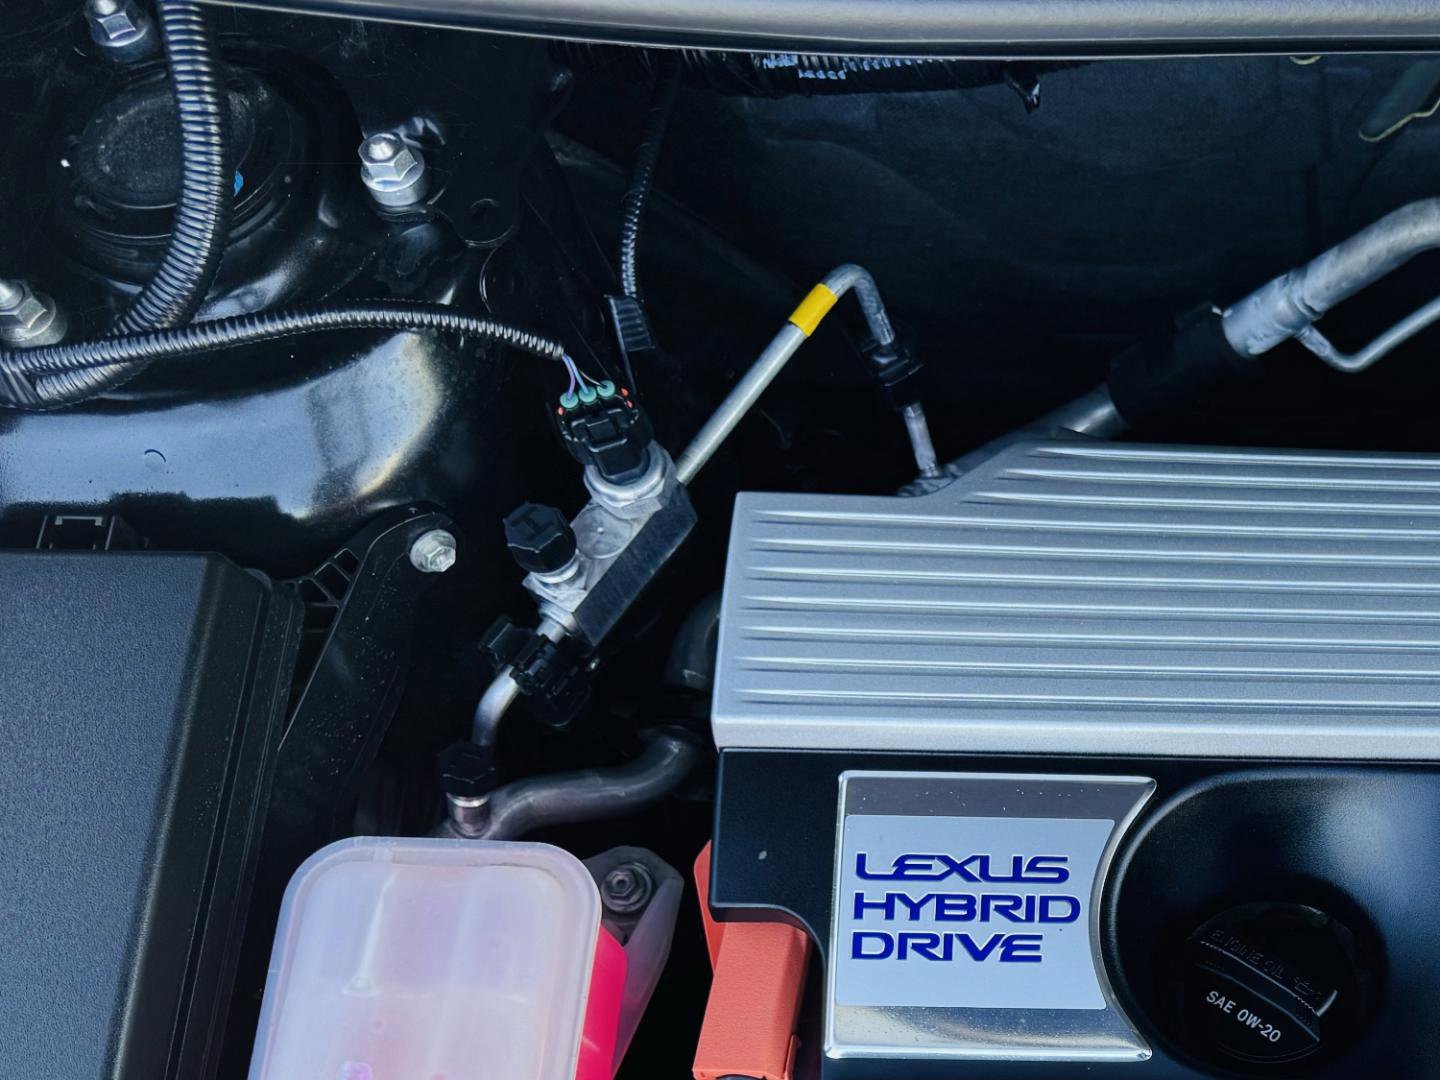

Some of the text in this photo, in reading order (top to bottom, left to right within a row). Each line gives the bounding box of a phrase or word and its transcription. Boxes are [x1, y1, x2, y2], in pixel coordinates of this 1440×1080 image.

[855, 853, 1070, 883] LEXUS
[853, 892, 1081, 923] HYBRID
[851, 931, 1043, 962] DRIVE
[1205, 990, 1282, 1043] SAE 0W-20
